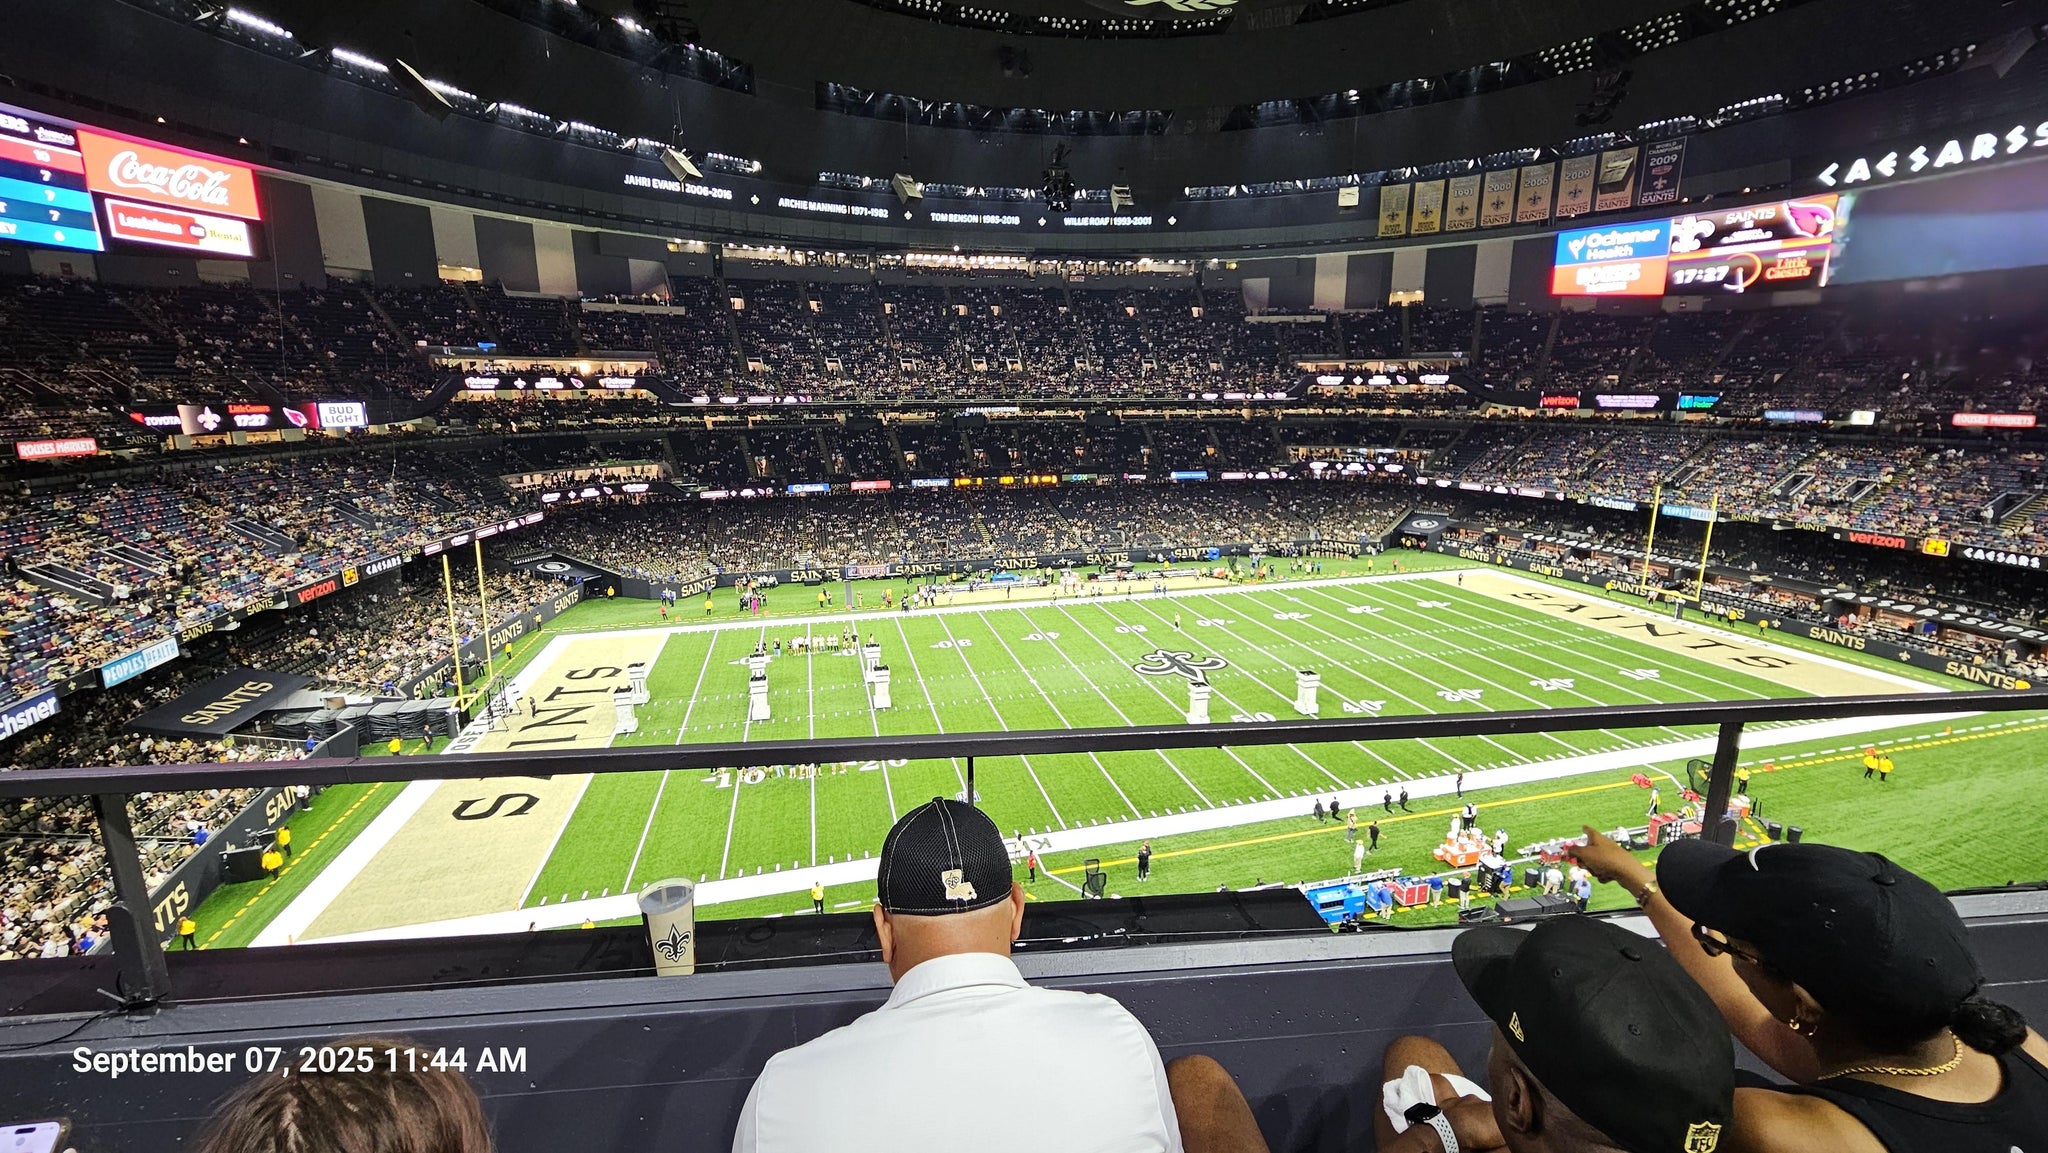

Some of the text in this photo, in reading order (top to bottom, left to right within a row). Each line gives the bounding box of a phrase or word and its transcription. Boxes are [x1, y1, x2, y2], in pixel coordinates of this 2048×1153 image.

[1650, 154, 1678, 166] 2009
[1818, 125, 2029, 187] CAESARS
[40, 169, 52, 182] 7
[108, 151, 231, 206] Coca-Cola
[1565, 169, 1591, 181] 2009
[623, 174, 733, 200] JAHRI EVANS 2006-2016
[1454, 188, 1473, 197] 1991
[1488, 182, 1512, 192] 2000
[1598, 200, 1629, 210] SAINTS
[1641, 192, 1675, 204] SAINTS
[778, 197, 889, 219] ARCHIE MANNING 1971-1982
[1558, 205, 1589, 216] SAINTS
[49, 209, 60, 222] 7
[930, 212, 948, 223] TOM
[948, 213, 979, 224] BENSON
[1064, 216, 1153, 226] WILLIE ROAF 1993-2001
[1482, 216, 1510, 225] SAINTS
[1518, 211, 1547, 221] SAINTS
[1725, 207, 1777, 224] SAINTS
[1447, 221, 1475, 230] SAINTS
[209, 229, 243, 243] Rental
[1586, 227, 1661, 248] Ochsner
[1586, 244, 1634, 261] Health
[1776, 257, 1808, 269] Little
[1673, 265, 1729, 284] 17:27
[1765, 267, 1812, 280] Caesars
[328, 406, 354, 415] BUD
[1765, 410, 1795, 419] VENTURE
[1885, 412, 1918, 420] SAINTS
[145, 415, 181, 427] TOYOTA
[324, 414, 361, 424] LIGHT
[1990, 415, 2034, 426] MARKETS
[125, 434, 158, 445] SAINTS
[20, 439, 97, 457] ROUSES MARKETS
[917, 479, 948, 487] Ochsner
[1597, 497, 1637, 511] Ochsner
[1662, 504, 1691, 518] PEOPLES
[1731, 513, 1760, 523] SAINTS
[1794, 522, 1827, 533] SAINTS
[1849, 531, 1906, 549] verizon
[1925, 539, 1947, 554] 25
[1086, 552, 1128, 566] SANTS
[1175, 547, 1209, 558] SAINT
[1459, 548, 1490, 562] SAINTS
[1602, 546, 1711, 569] SUPERDOME
[1963, 547, 2041, 569] CAESARS
[366, 556, 401, 575] CAESARS
[895, 562, 942, 575] SAINTS
[994, 556, 1038, 571] SAINTS
[343, 568, 357, 584] 25
[298, 580, 336, 603] verizon
[681, 575, 717, 597] SAINTS
[1610, 579, 1648, 597] SAINTS
[246, 598, 274, 616] SAINTS
[554, 590, 579, 614] SAINTS
[181, 622, 214, 643] SAINTS
[491, 620, 523, 650] SAINTS
[1511, 592, 1798, 669] SAINTS
[1809, 627, 1866, 651] SAINTS
[103, 640, 179, 683] PEOPLES HEALTH
[1619, 668, 1660, 680] 10
[1946, 661, 2016, 690] SAINTS
[1529, 677, 1571, 691] 20
[1436, 688, 1482, 702] 30
[181, 680, 274, 726] SAINTS
[1343, 699, 1384, 714] 40
[452, 665, 622, 821] SINTS
